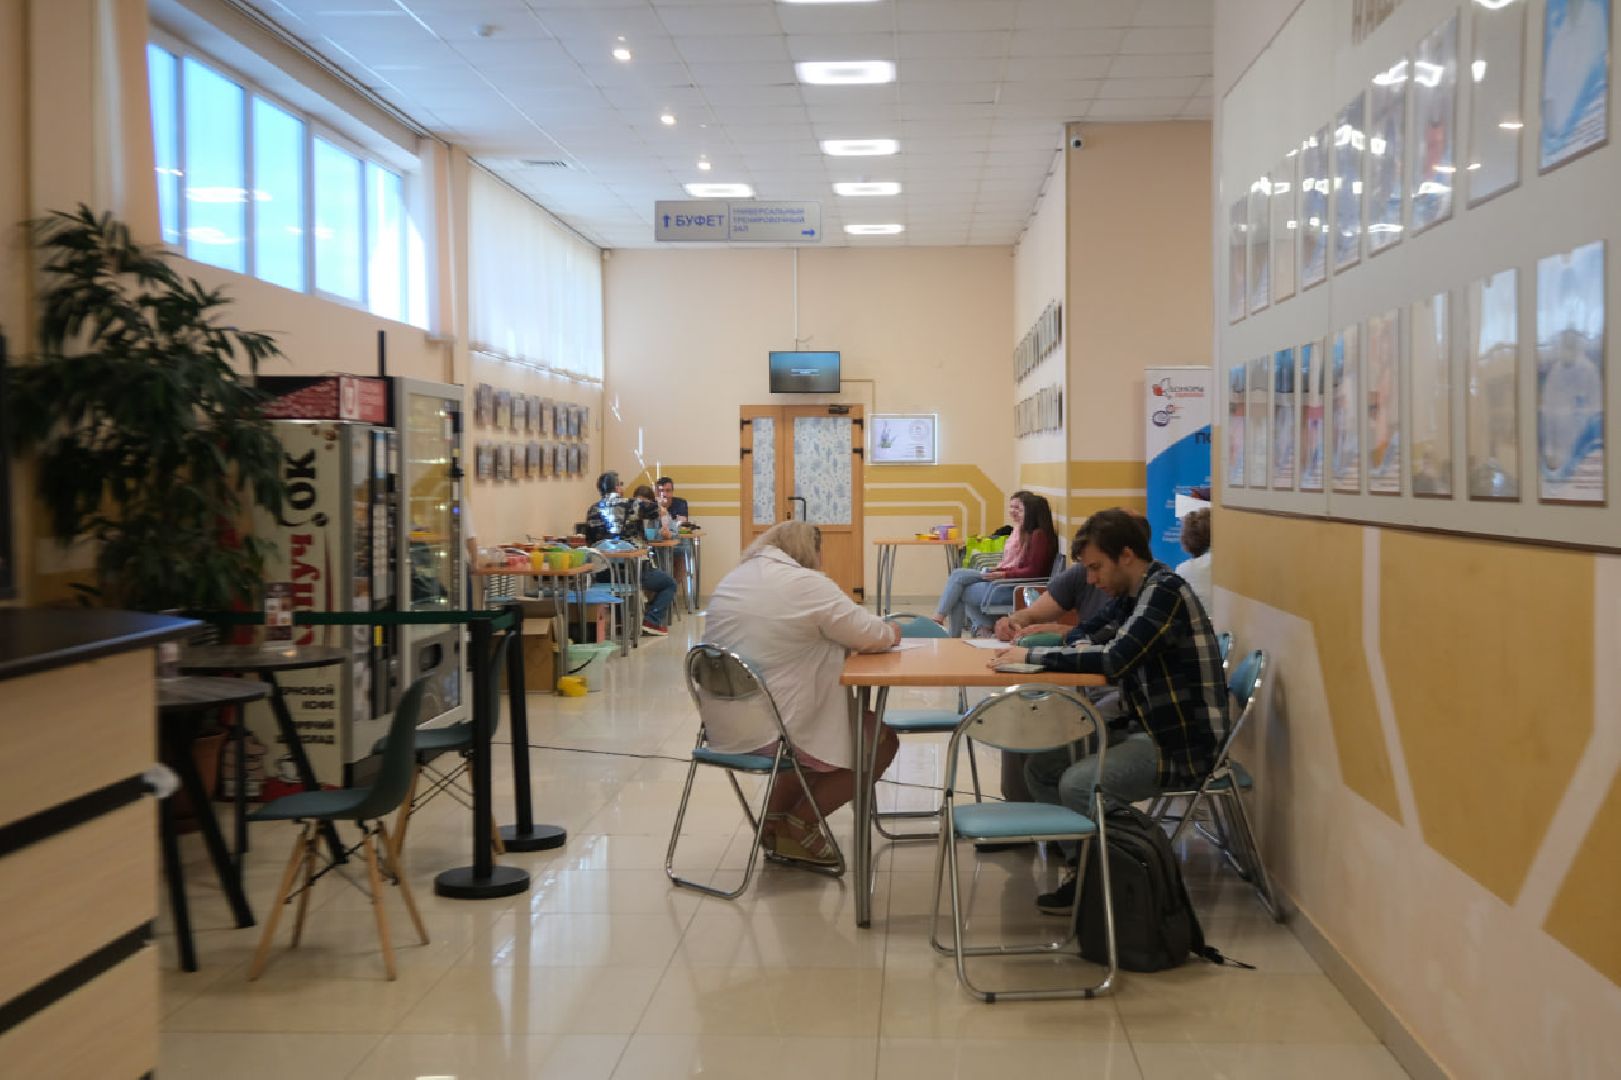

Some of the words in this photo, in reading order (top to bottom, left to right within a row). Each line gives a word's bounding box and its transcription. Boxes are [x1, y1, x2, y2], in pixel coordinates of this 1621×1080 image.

[732, 207, 805, 216] УНИВЕРСАЛЬНЫЙ
[675, 214, 725, 227] БУФЕТ
[732, 216, 805, 224] ТРЕНИРОВОЧНЫЙ
